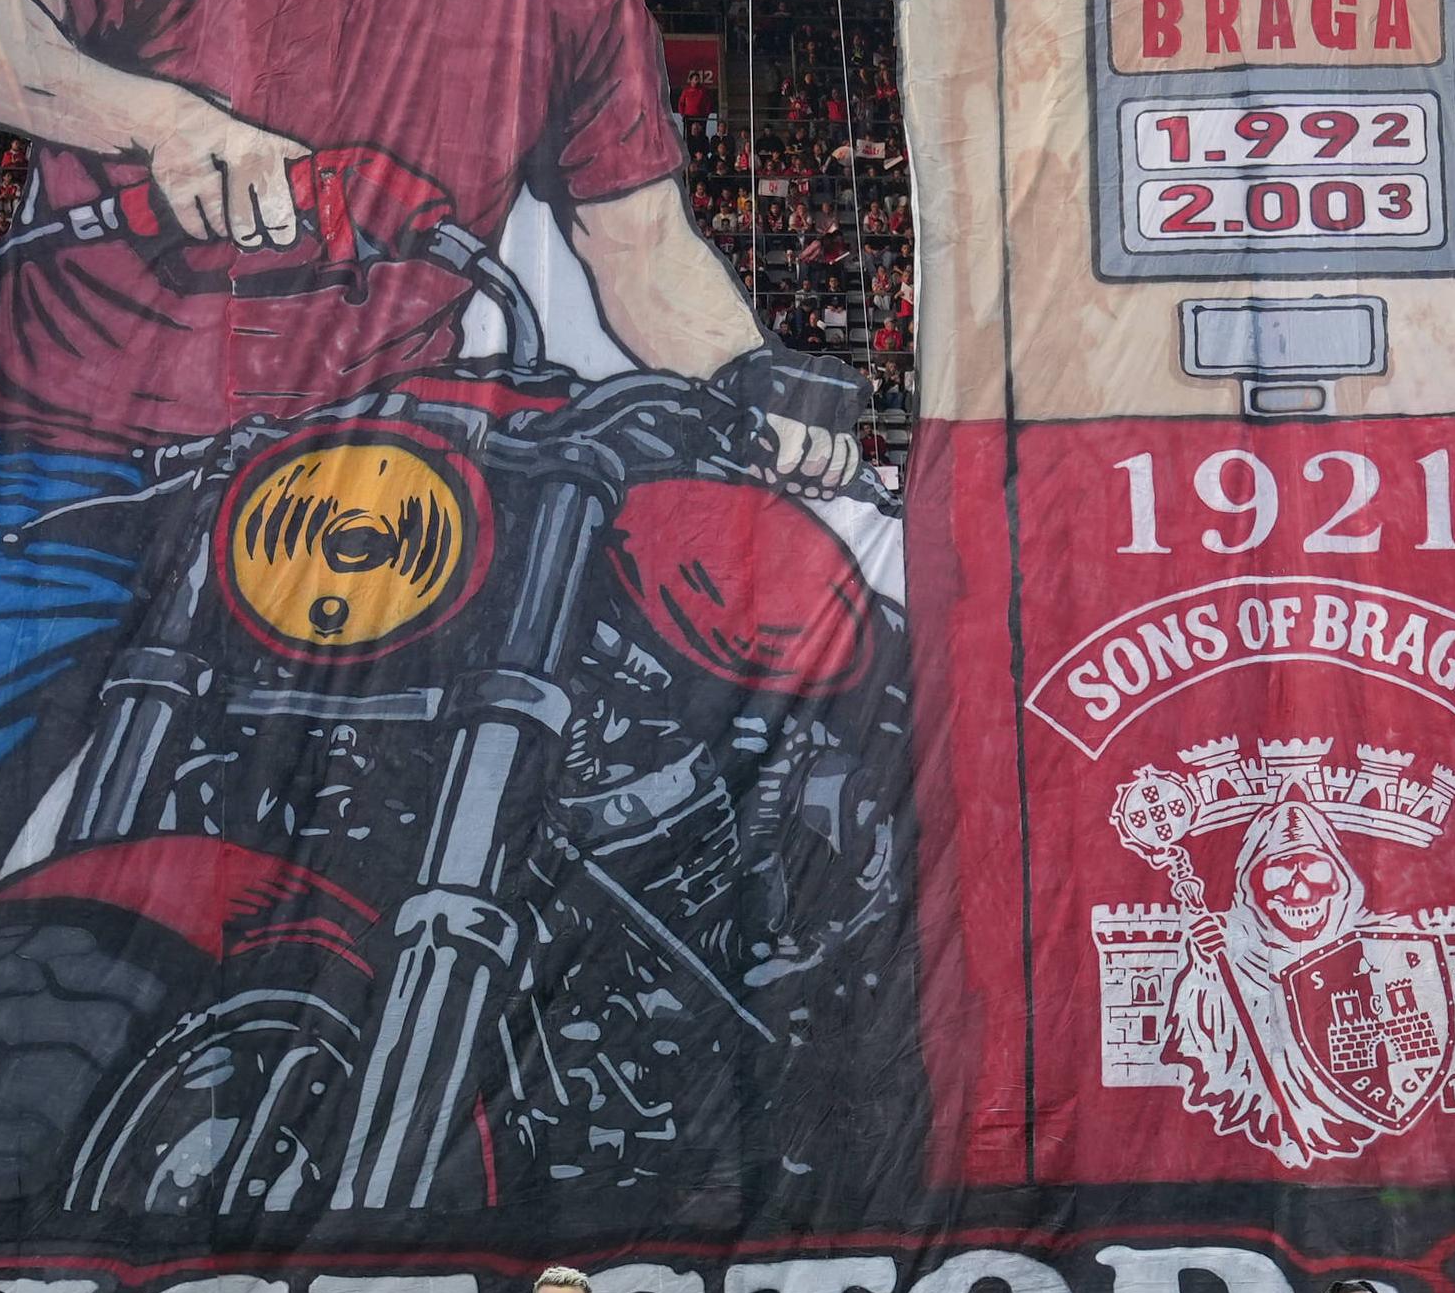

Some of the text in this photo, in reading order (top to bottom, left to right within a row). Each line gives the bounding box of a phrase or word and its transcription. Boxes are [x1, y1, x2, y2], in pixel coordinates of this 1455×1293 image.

[1156, 110, 1411, 162] 1.992
[1159, 181, 1413, 233] 2.003
[1068, 604, 1228, 721] SONS
[1237, 596, 1301, 650] OF
